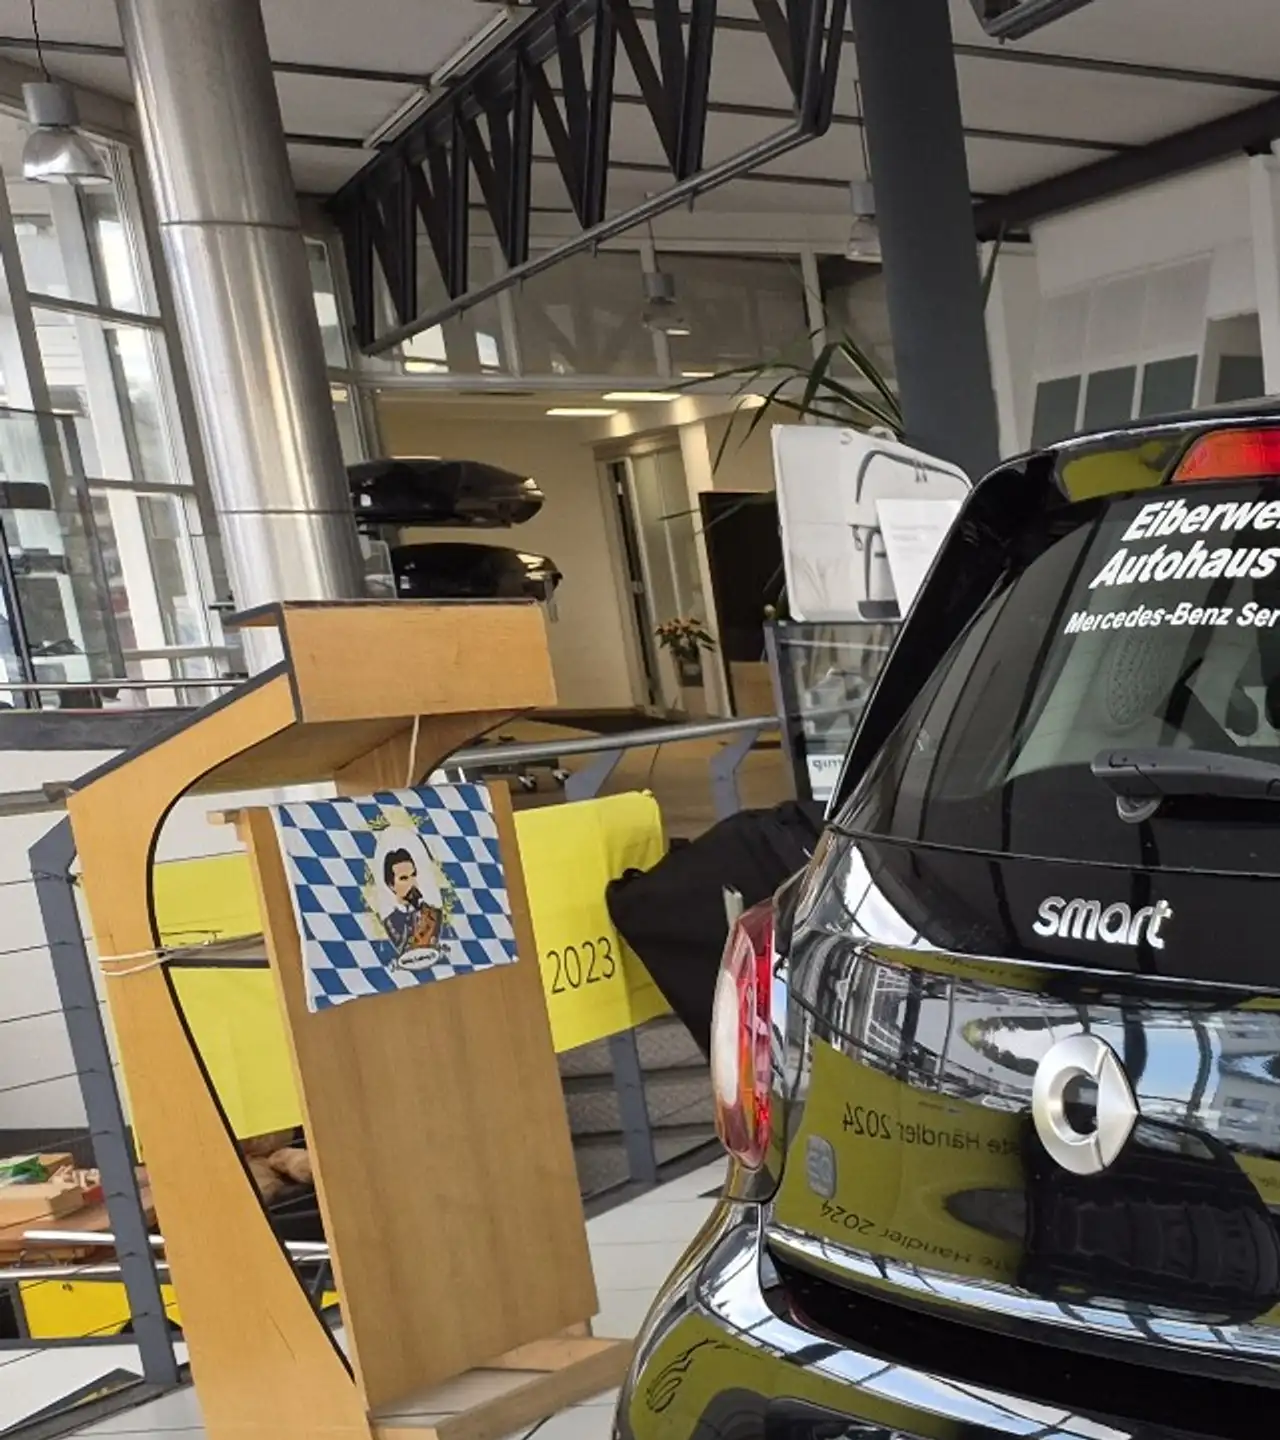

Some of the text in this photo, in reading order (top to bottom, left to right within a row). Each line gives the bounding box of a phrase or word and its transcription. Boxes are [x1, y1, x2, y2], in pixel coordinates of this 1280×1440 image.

[1064, 603, 1234, 635] Mercedes-Benz
[1032, 896, 1174, 949] smart
[546, 936, 616, 995] 2023
